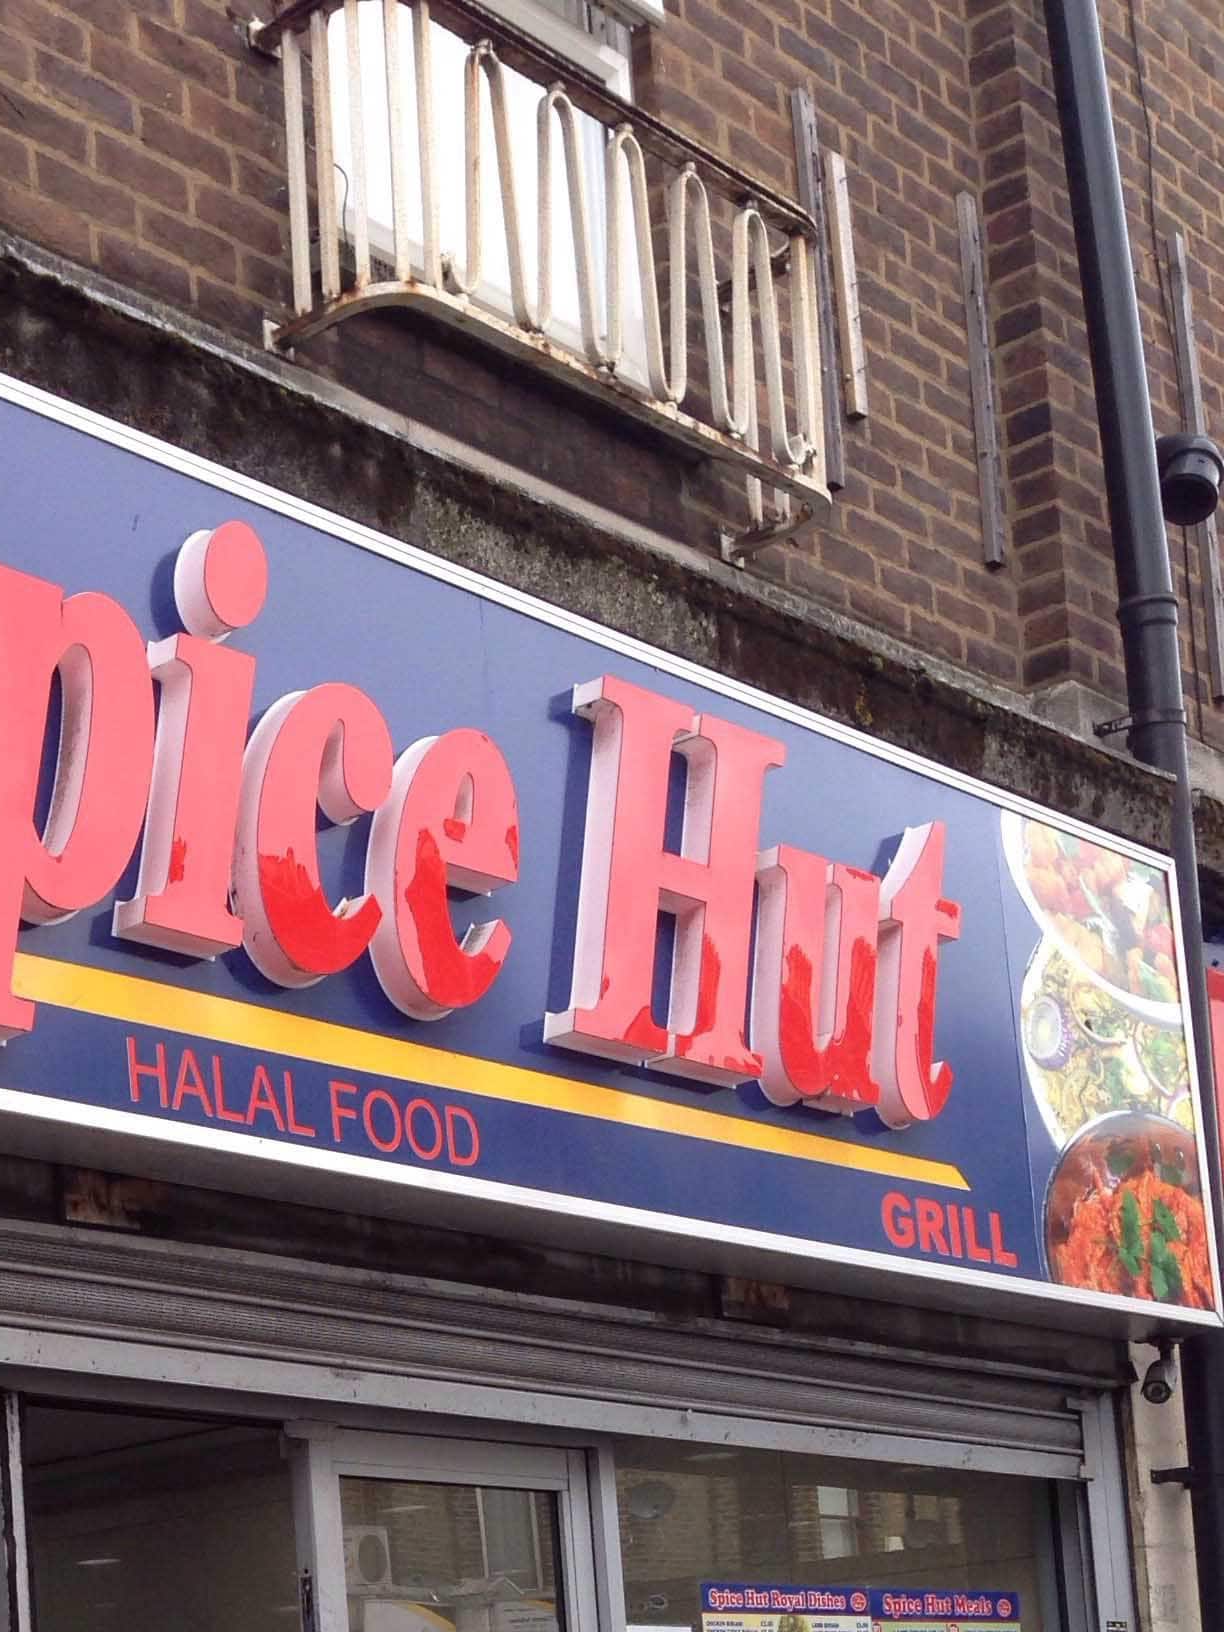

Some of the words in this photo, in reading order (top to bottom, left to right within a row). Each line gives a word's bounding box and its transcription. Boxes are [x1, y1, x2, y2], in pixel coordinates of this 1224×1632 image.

[543, 674, 961, 1130] Hut
[126, 1036, 316, 1138] HALAL
[328, 1080, 481, 1167] FOOD
[881, 1192, 1018, 1268] GRILL
[709, 1588, 744, 1610] Spice
[745, 1589, 769, 1608] Hut
[771, 1591, 807, 1611] Royal
[807, 1591, 846, 1610] Dishes
[883, 1593, 922, 1618] Spice
[925, 1594, 952, 1615] Hut
[953, 1595, 992, 1616] Meals
